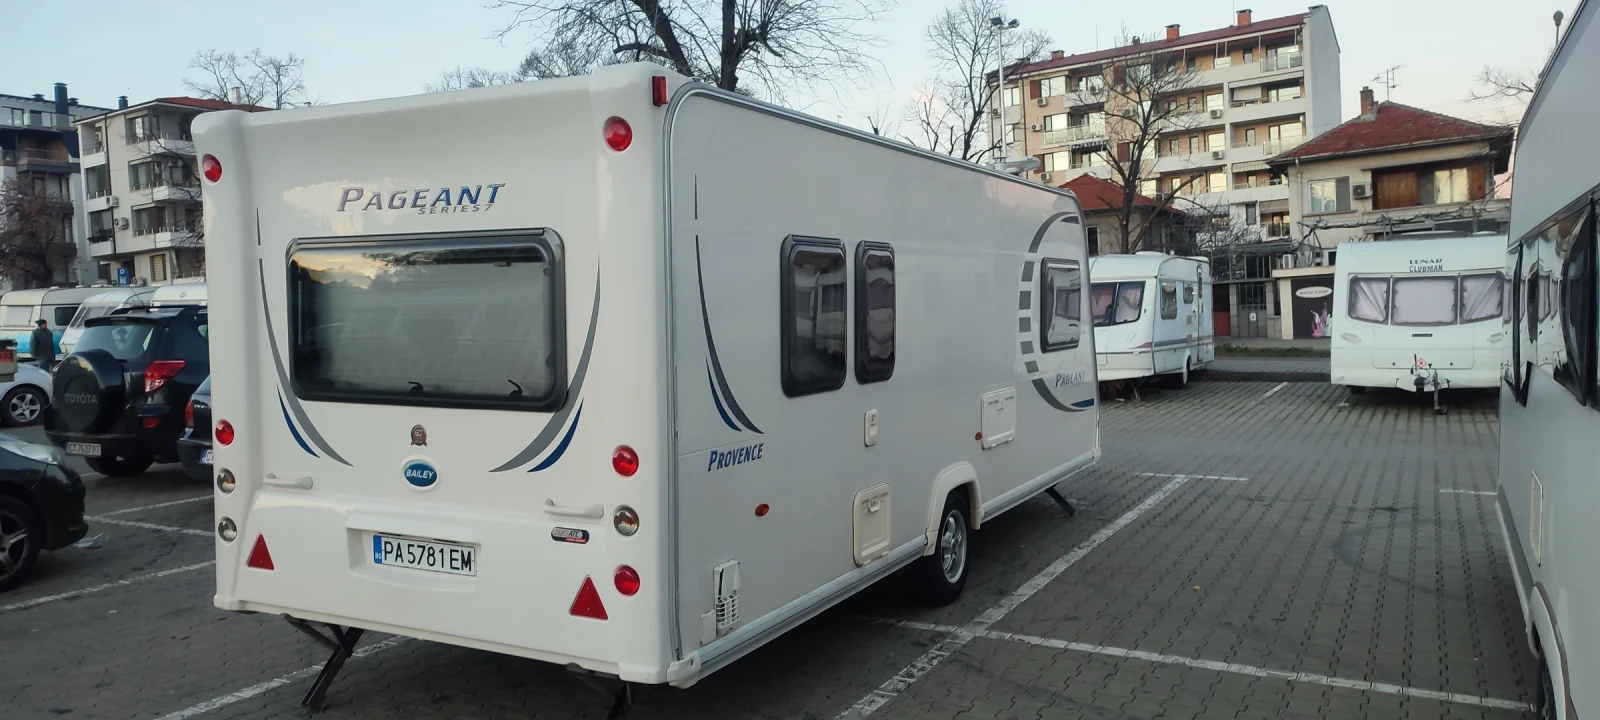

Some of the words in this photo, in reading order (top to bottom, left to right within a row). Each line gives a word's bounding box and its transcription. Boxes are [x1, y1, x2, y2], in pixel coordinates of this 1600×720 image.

[337, 183, 506, 212] PAGEANT
[1055, 371, 1086, 388] PAGEANT
[64, 393, 99, 405] TOYOTA
[708, 442, 764, 472] PROVENCE
[406, 469, 435, 479] BAILEY
